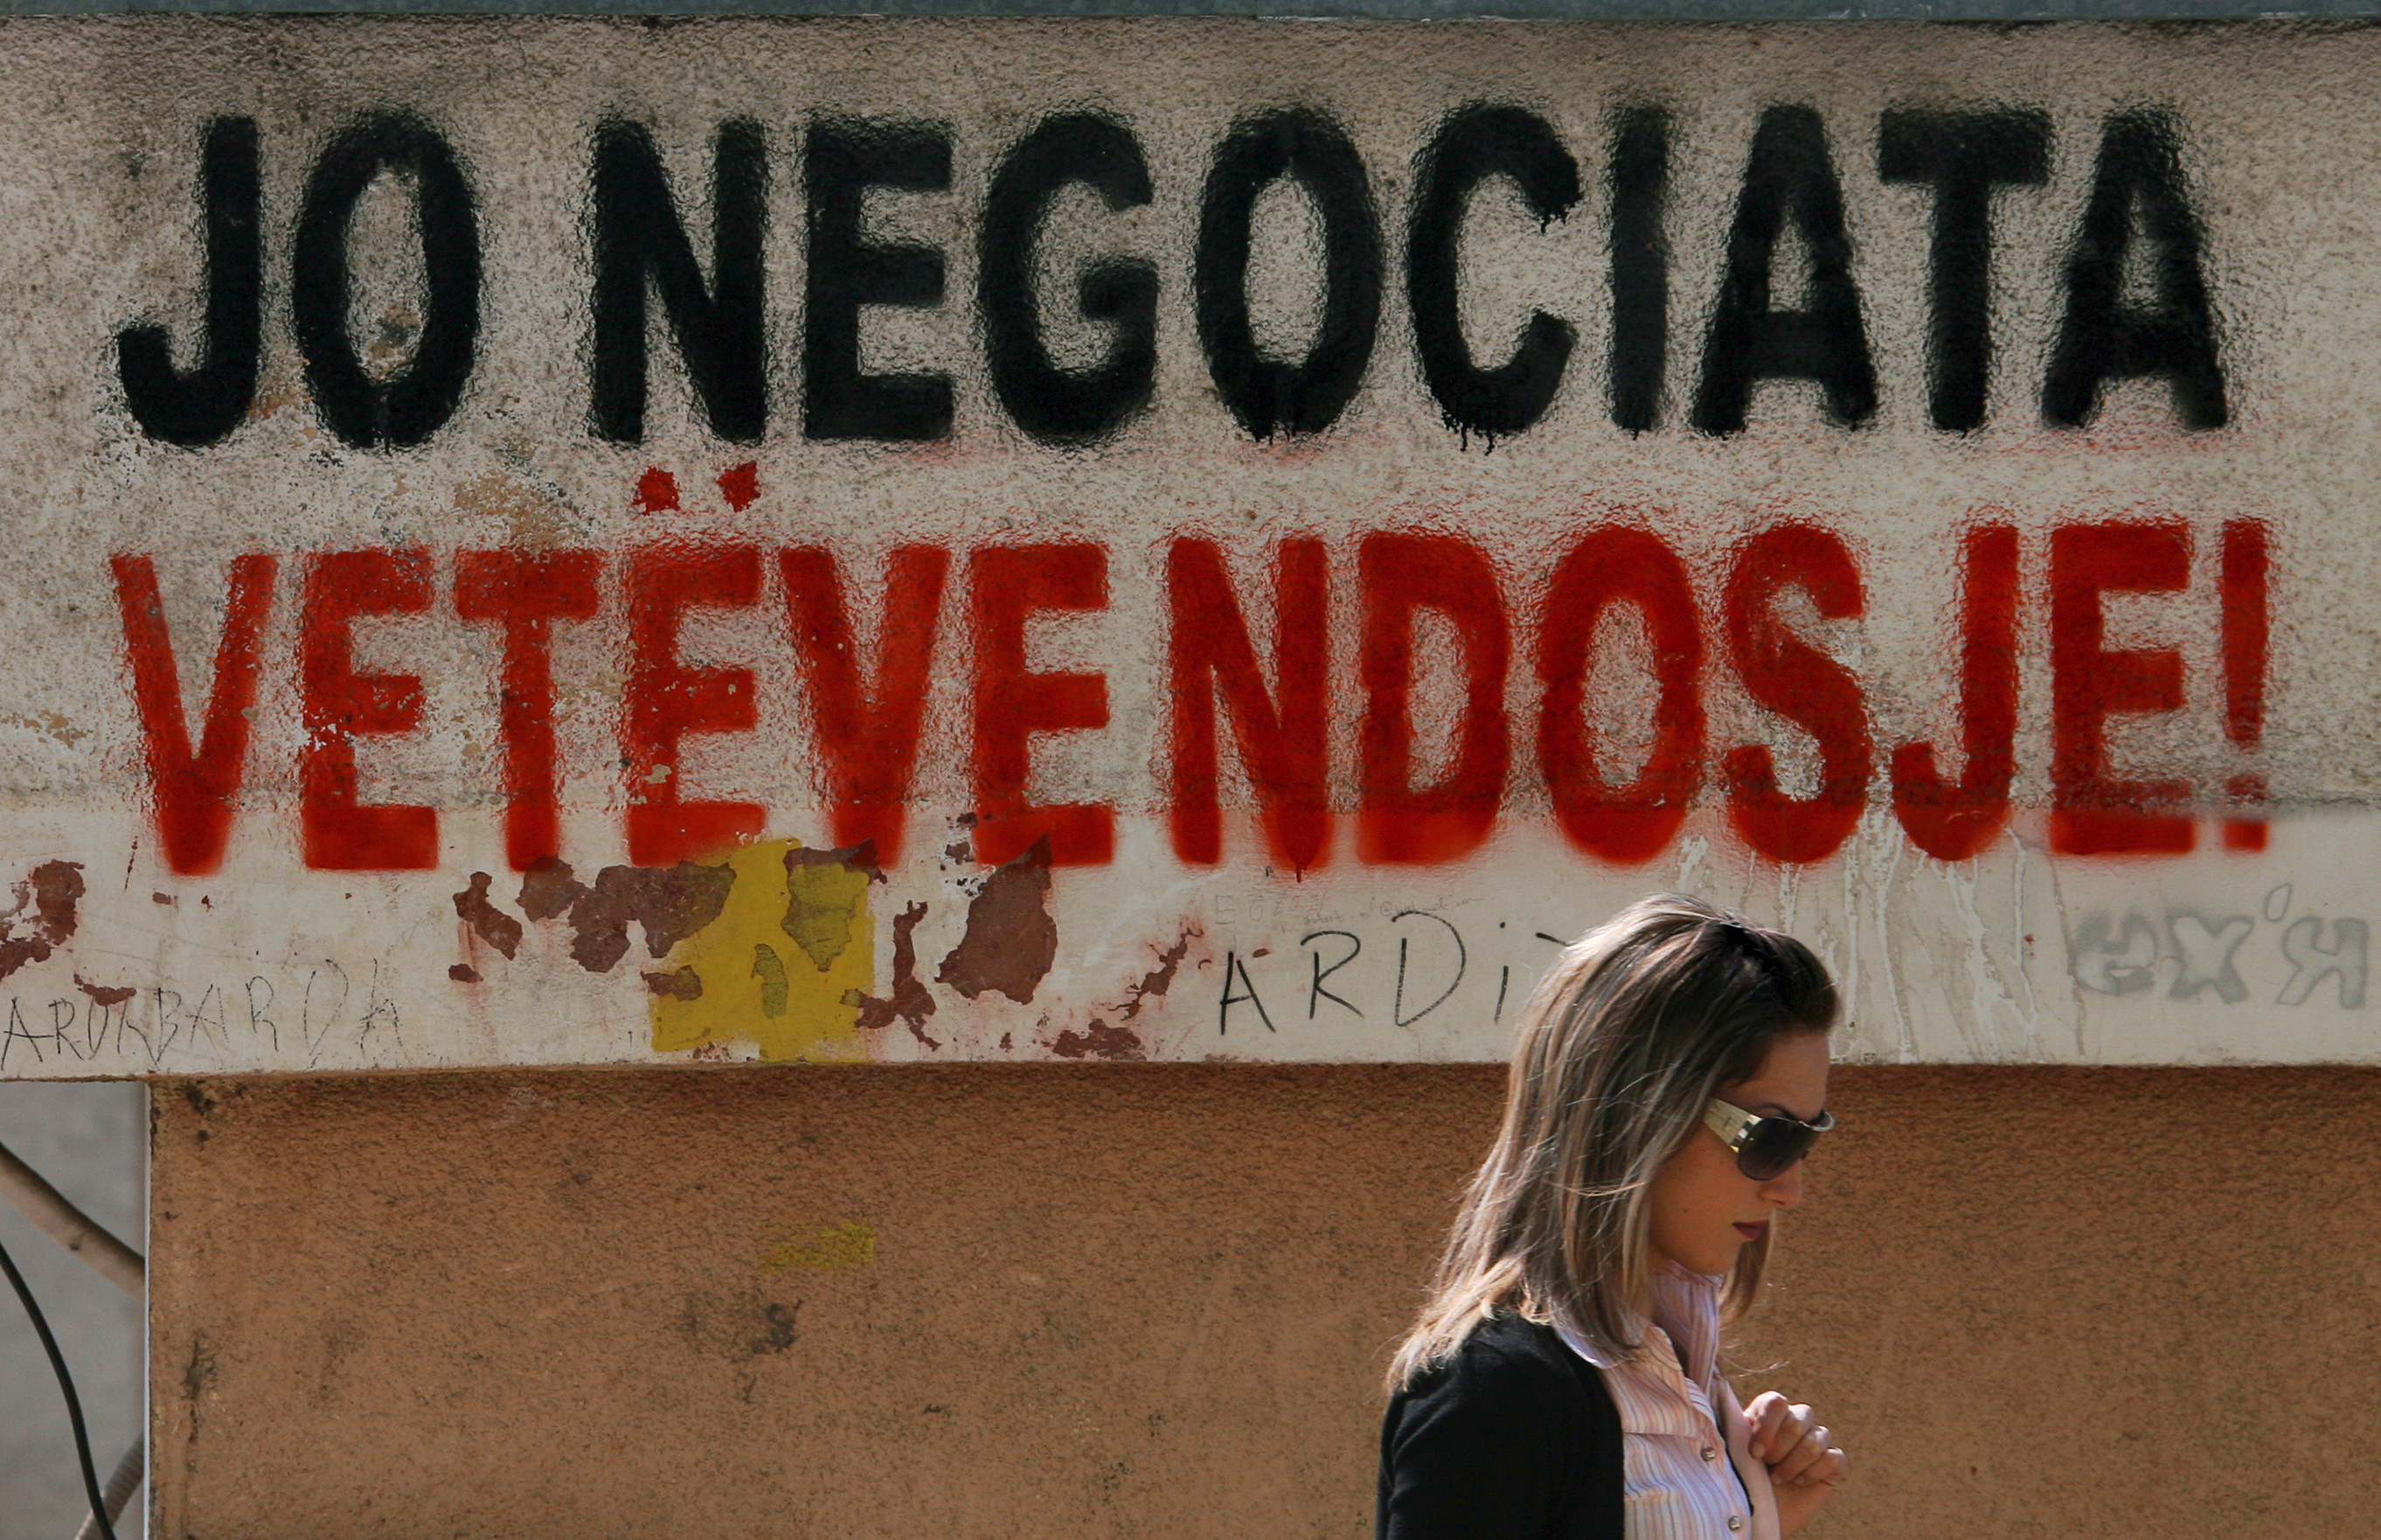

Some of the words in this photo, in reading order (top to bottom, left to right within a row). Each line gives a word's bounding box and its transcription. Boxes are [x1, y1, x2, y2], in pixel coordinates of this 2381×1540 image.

[116, 110, 481, 448] JO
[590, 103, 2229, 442] NEGOCIATA
[110, 461, 2271, 876] VETËVENDOSJE!
[1219, 910, 1573, 1036] ARDi
